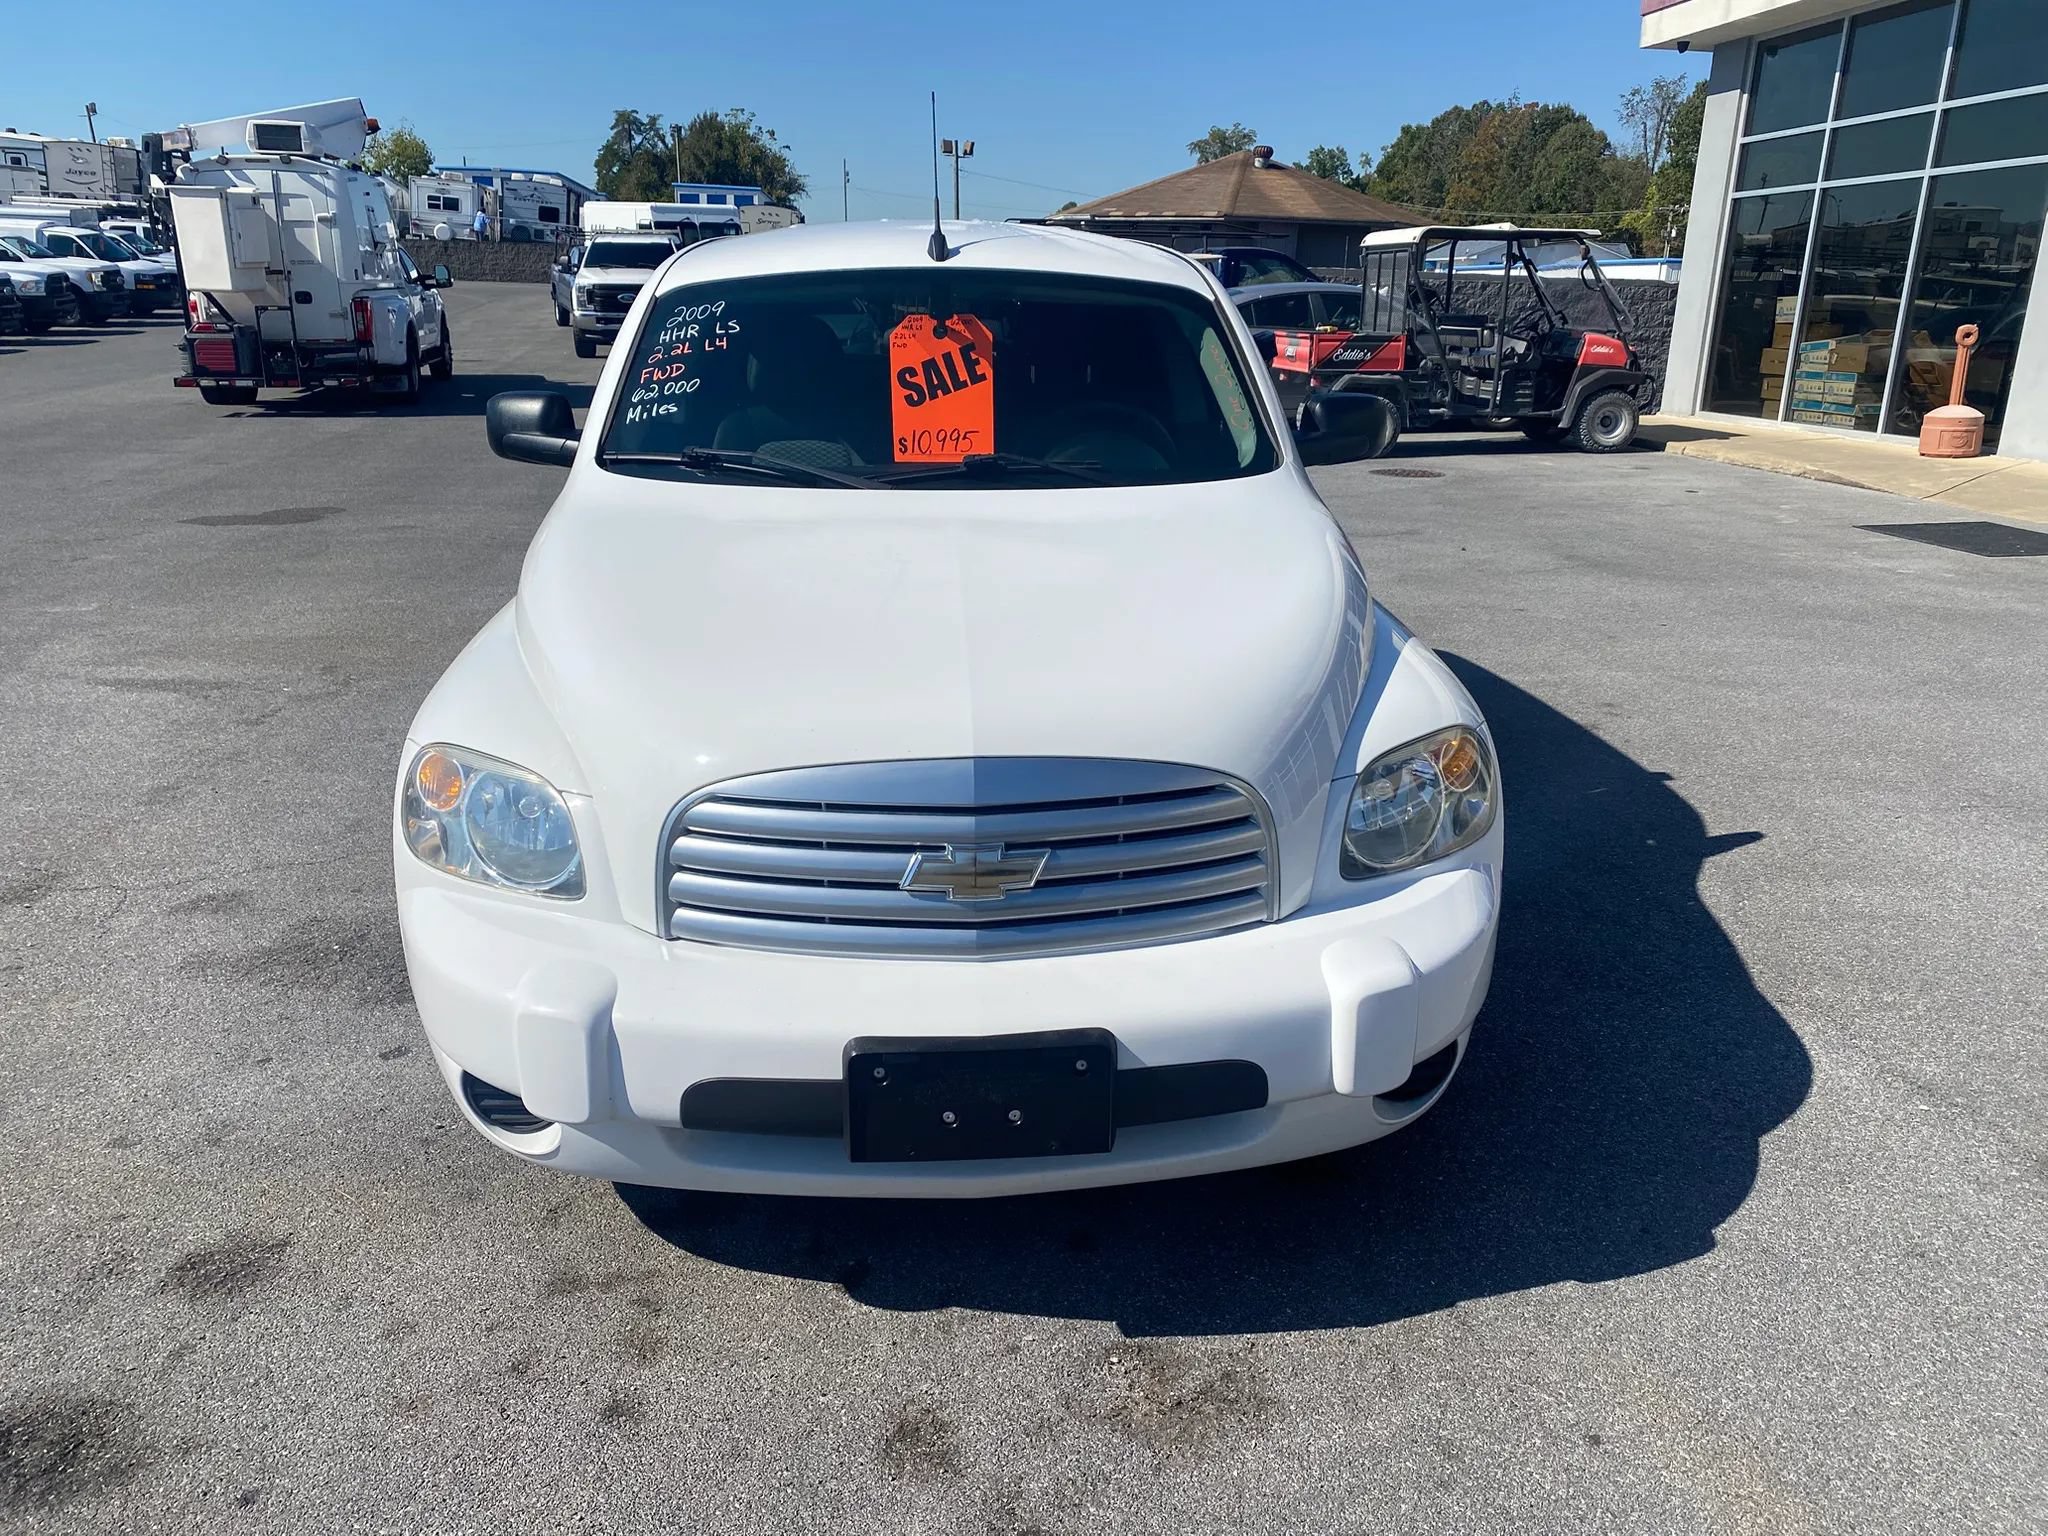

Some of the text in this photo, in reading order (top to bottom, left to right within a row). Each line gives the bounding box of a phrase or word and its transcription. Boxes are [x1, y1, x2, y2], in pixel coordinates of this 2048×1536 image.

[65, 168, 96, 176] Jayco
[666, 300, 725, 328] 2009
[659, 319, 740, 344] HHR LS
[648, 336, 727, 364] 2.2L L4
[892, 341, 908, 349] FWD
[1332, 348, 1372, 362] Eddie's
[641, 363, 685, 384] FWD
[896, 342, 988, 407] SALE
[632, 378, 700, 403] 62,000
[626, 402, 678, 425] Miles
[898, 427, 980, 455] $10,995
